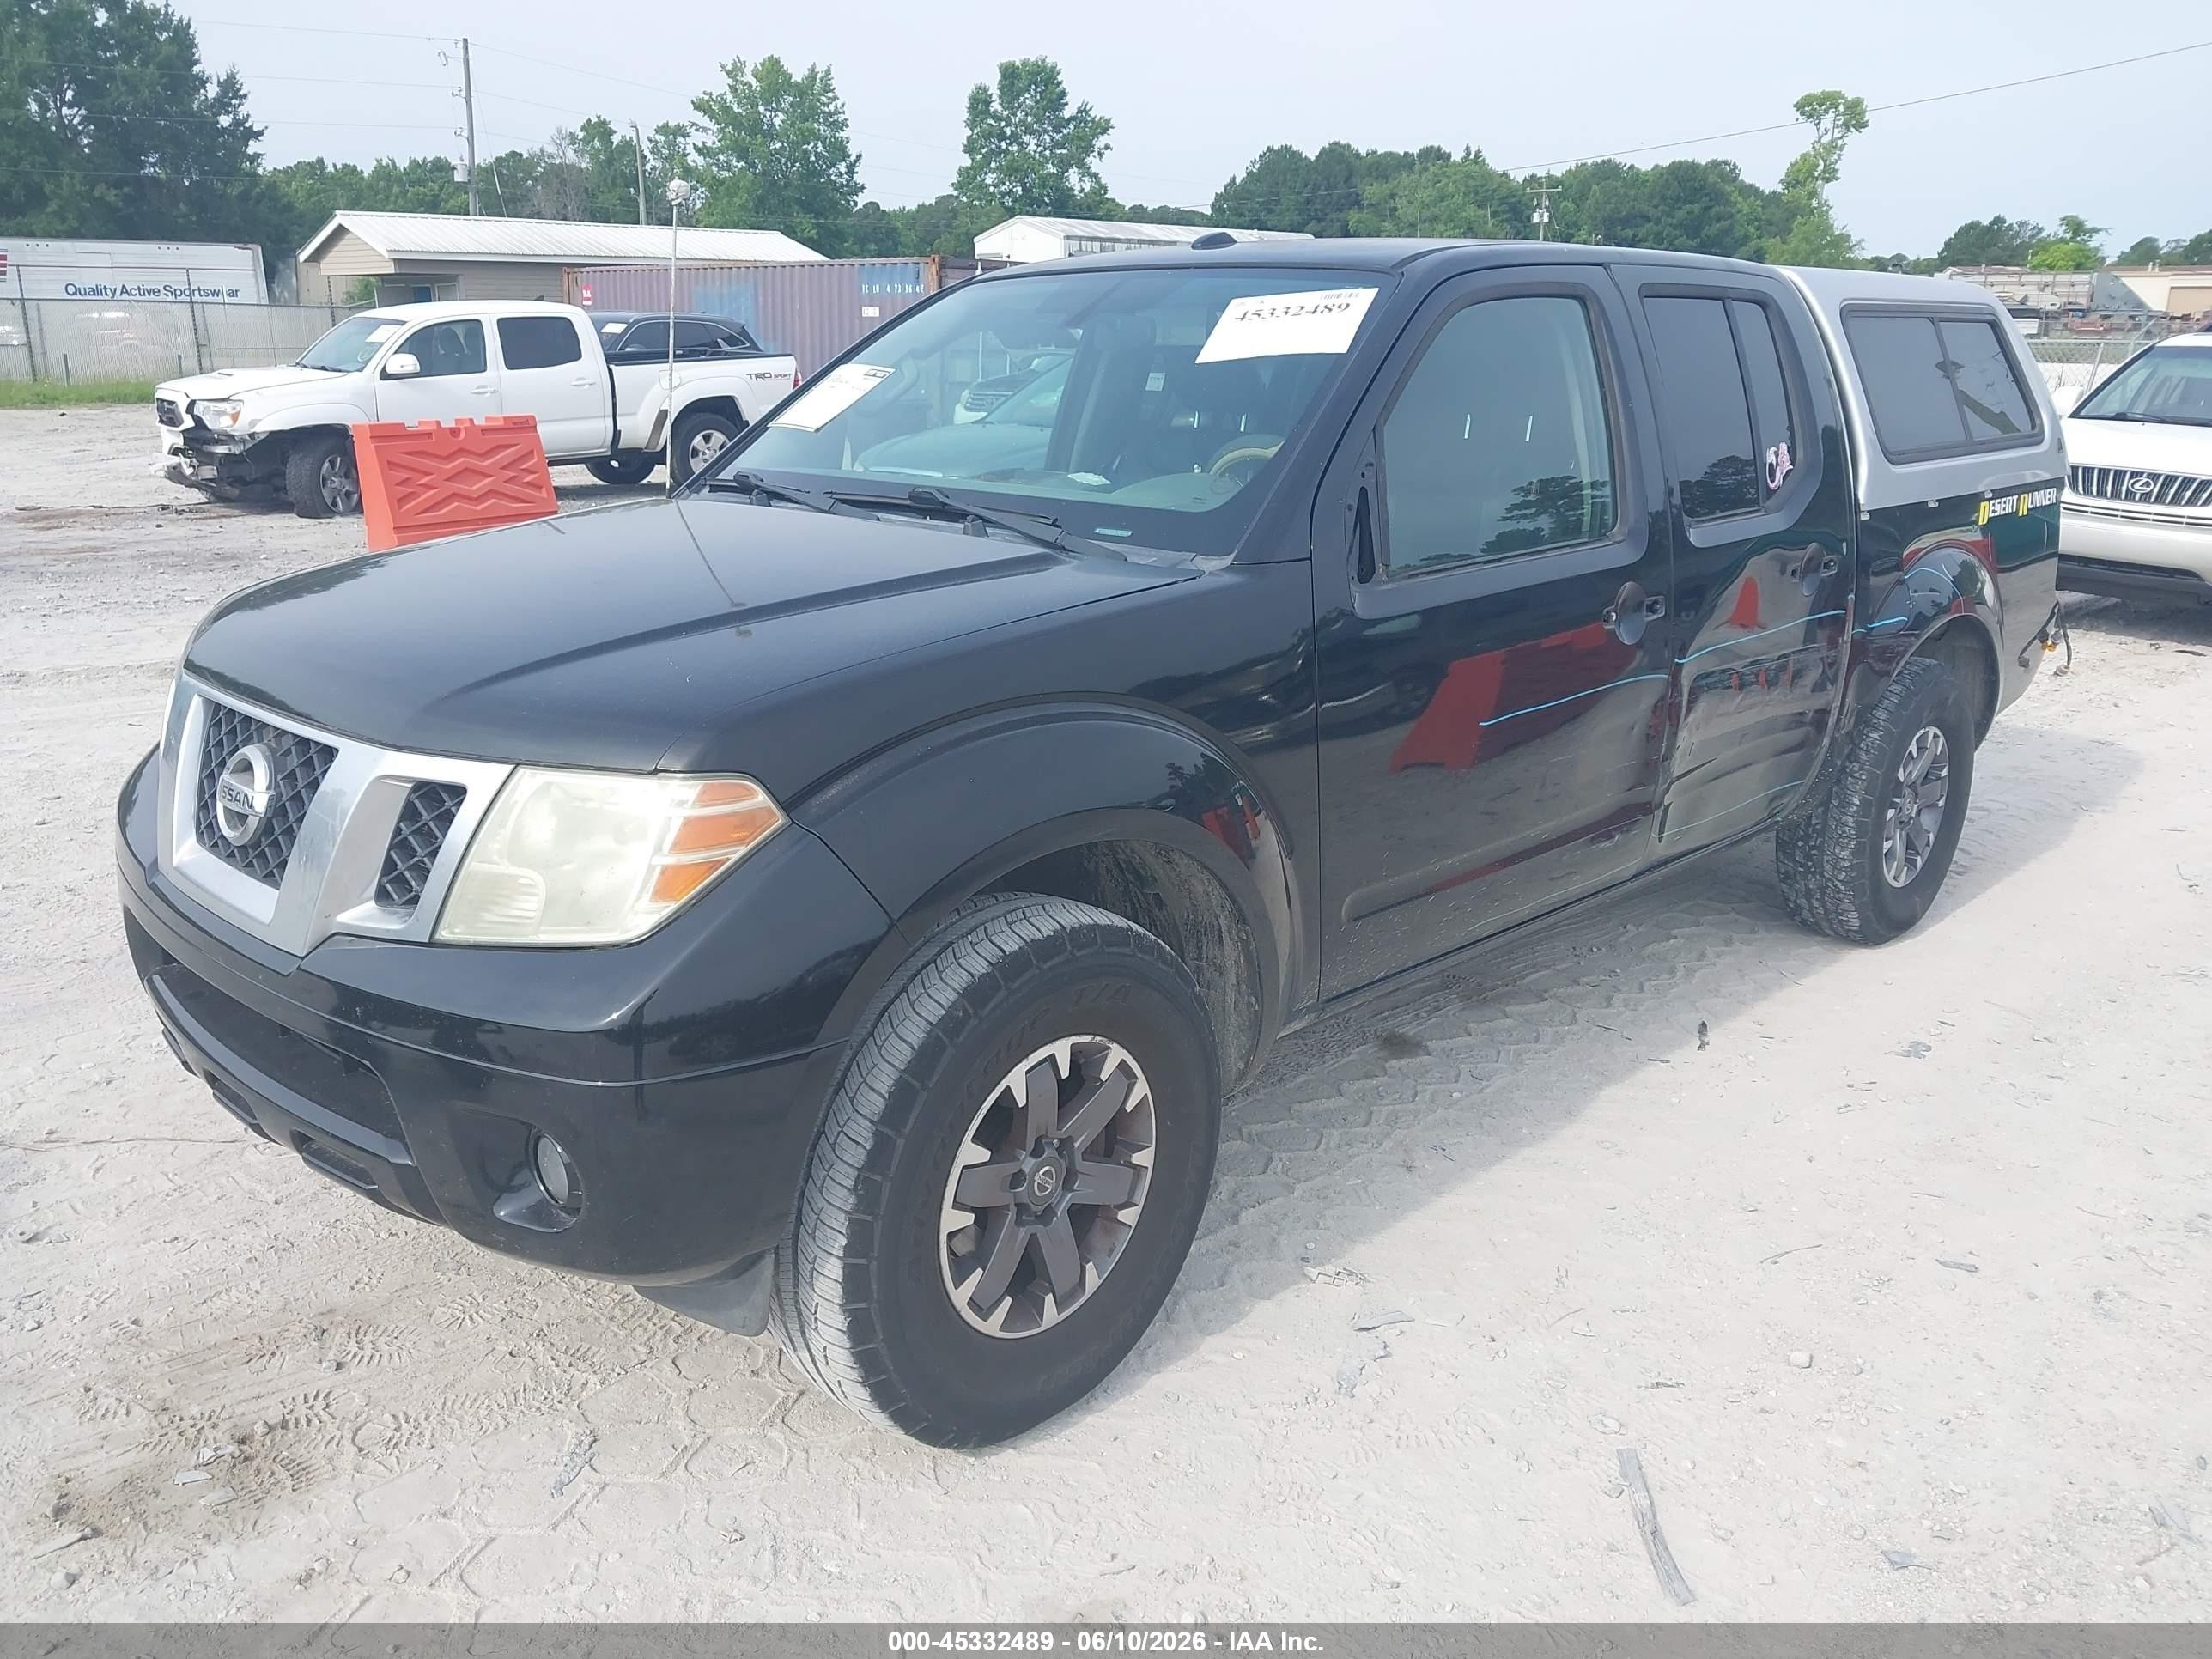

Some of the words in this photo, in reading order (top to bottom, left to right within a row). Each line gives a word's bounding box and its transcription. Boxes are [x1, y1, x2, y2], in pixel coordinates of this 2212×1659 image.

[64, 283, 117, 299] Quality
[119, 283, 161, 297] Active
[163, 283, 240, 300] Sportswar
[1234, 302, 1352, 322] 45332489
[1978, 495, 2019, 526] DESERT
[2018, 487, 2057, 517] RUNNER
